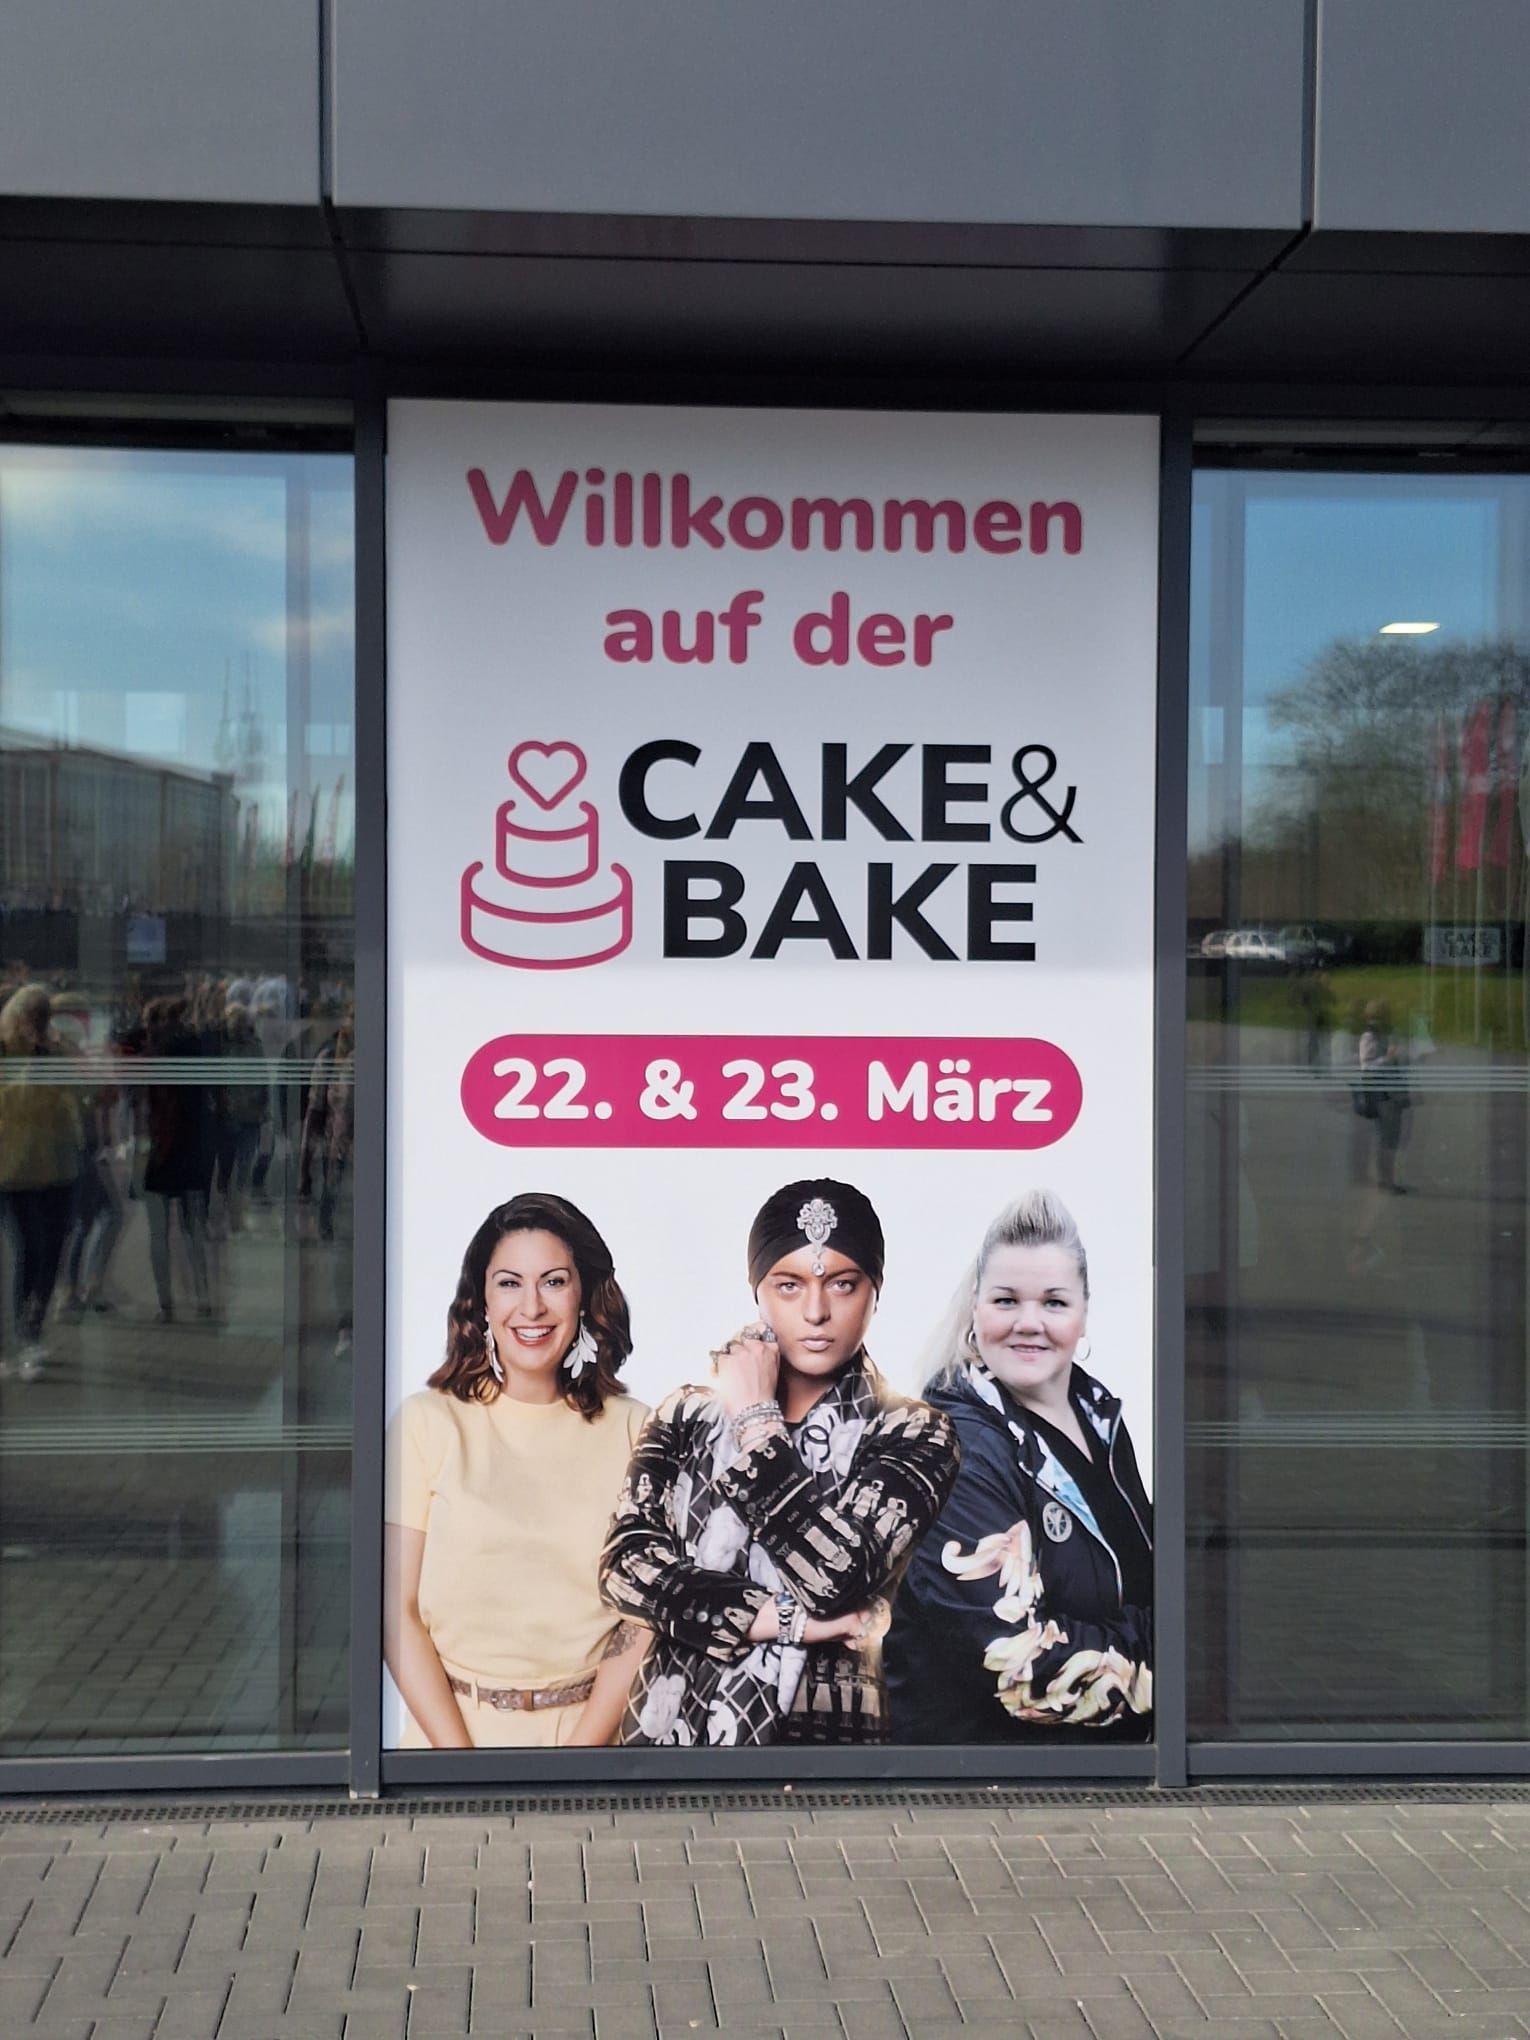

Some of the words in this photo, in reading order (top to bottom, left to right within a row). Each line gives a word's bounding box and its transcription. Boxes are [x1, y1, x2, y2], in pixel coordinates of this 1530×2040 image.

[467, 468, 1083, 554] Willkommen
[603, 590, 765, 666] auf
[793, 591, 955, 668] der
[663, 860, 1037, 961] BAKE
[493, 1058, 613, 1120] 22.
[639, 1059, 698, 1121] &
[721, 1059, 839, 1121] 23.
[867, 1059, 1053, 1122] März
